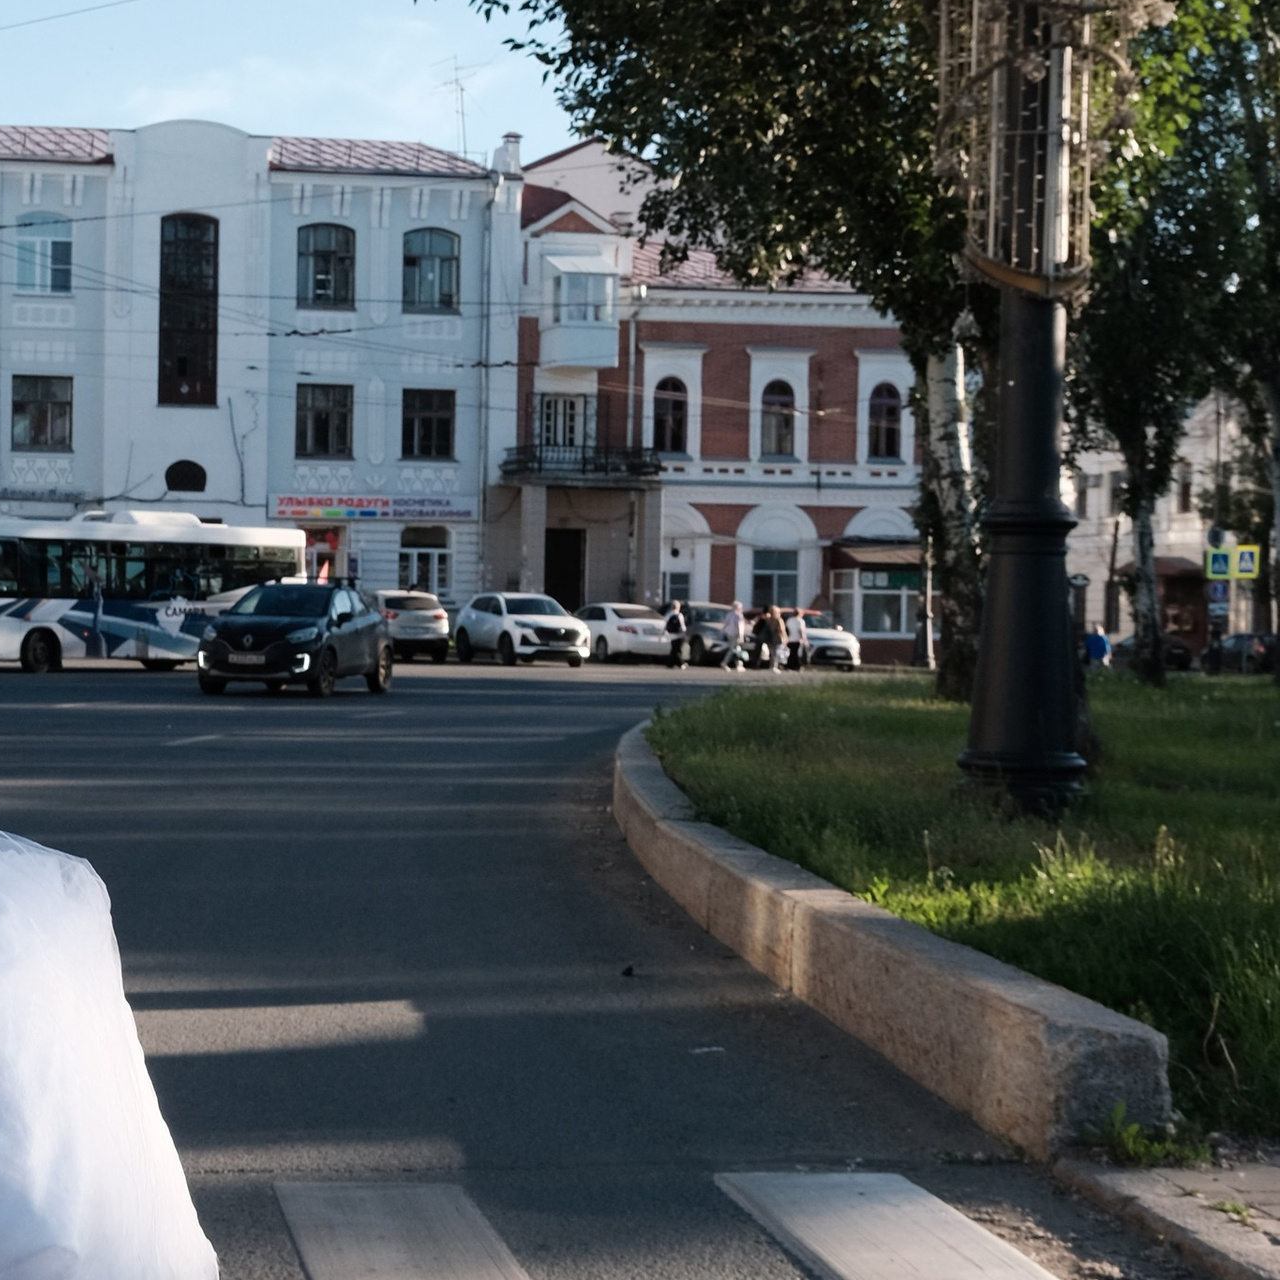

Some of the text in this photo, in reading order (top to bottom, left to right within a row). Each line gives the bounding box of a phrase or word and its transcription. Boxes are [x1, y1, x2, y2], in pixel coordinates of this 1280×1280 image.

[278, 496, 390, 509] УЛЫБКА РАДУГИ
[392, 498, 451, 507] КОСМЕТИКА
[392, 509, 437, 518] БЫТОВАЯ
[165, 606, 206, 618] САМАРА
